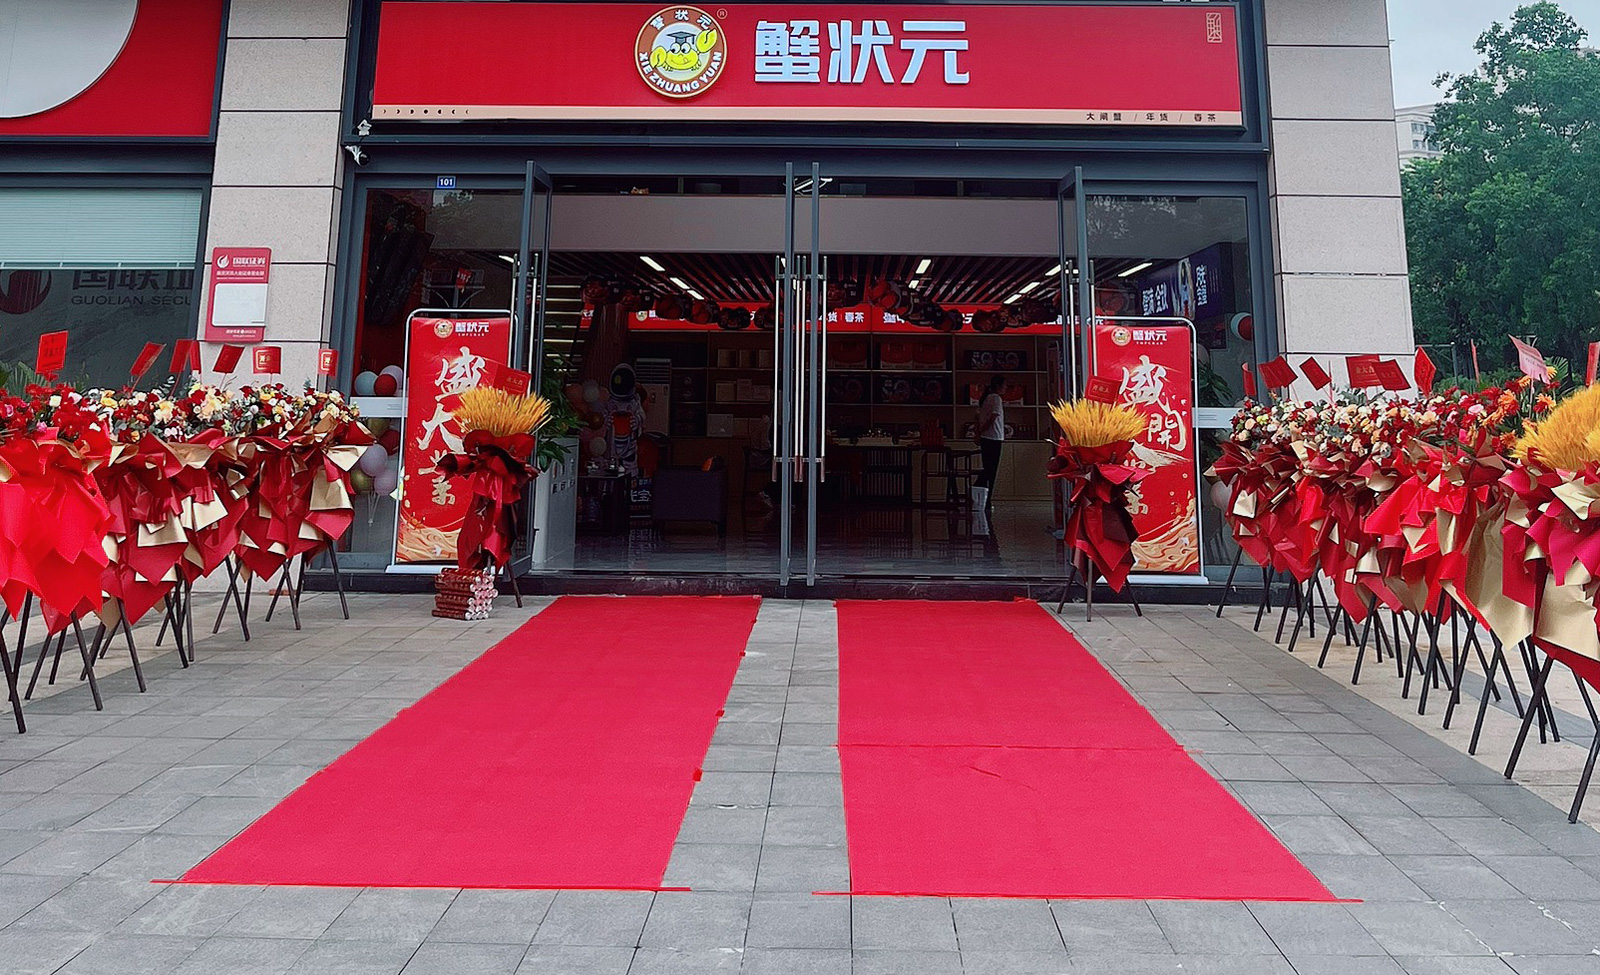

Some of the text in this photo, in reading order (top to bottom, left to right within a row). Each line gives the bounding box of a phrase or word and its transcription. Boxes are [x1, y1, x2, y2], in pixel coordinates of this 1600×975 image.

[755, 20, 970, 84] 蟹状元
[639, 51, 722, 93] XIE ZHUANG YUAN
[1146, 112, 1168, 121] 年货
[440, 178, 453, 186] 101
[71, 295, 144, 306] GUOLIAN
